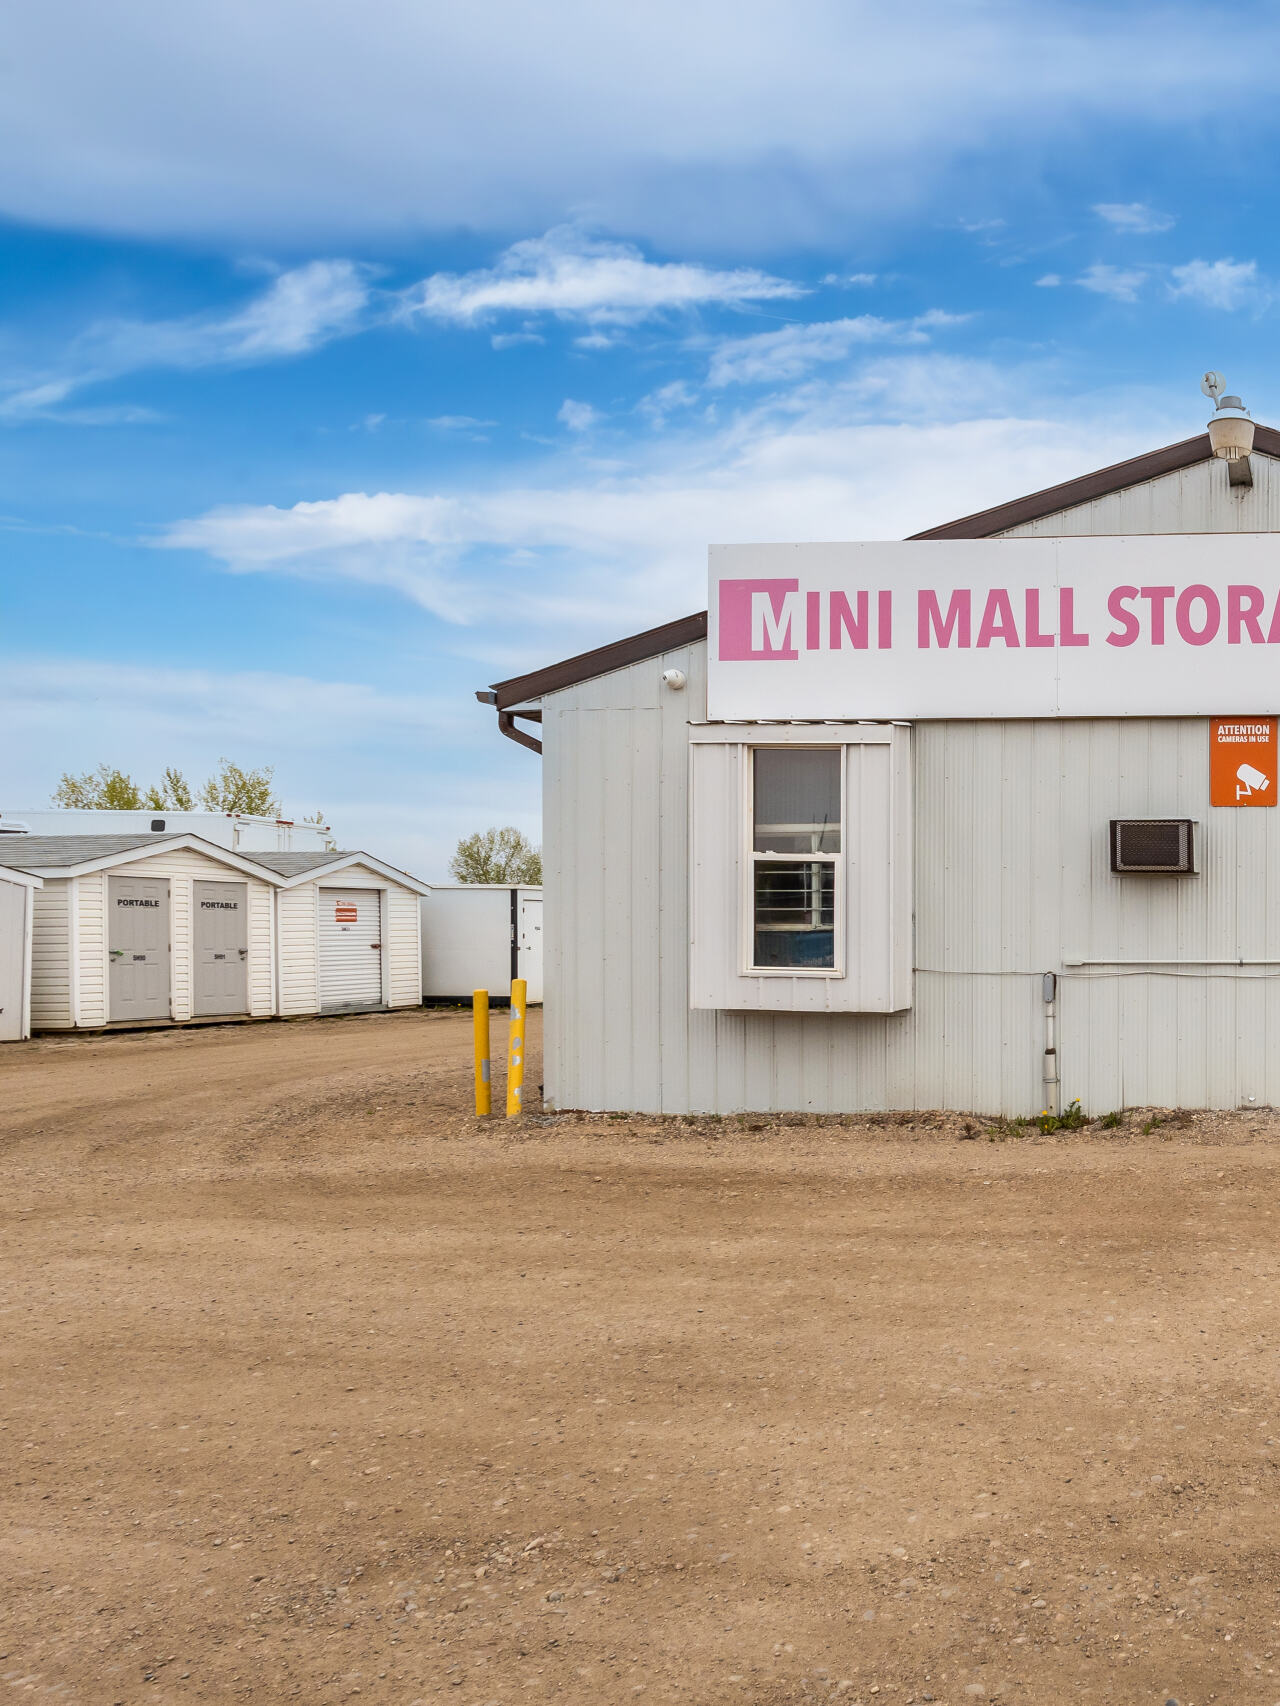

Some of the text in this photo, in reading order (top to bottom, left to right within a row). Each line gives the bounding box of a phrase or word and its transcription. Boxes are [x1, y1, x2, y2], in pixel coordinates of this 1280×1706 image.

[750, 589, 893, 652] MINI
[917, 586, 1090, 649] MALL
[1217, 724, 1270, 735] ATTENTION
[1217, 735, 1270, 743] CAMERAS IN USE
[117, 899, 160, 908] PORTABLE
[200, 901, 239, 910] PORTABLE
